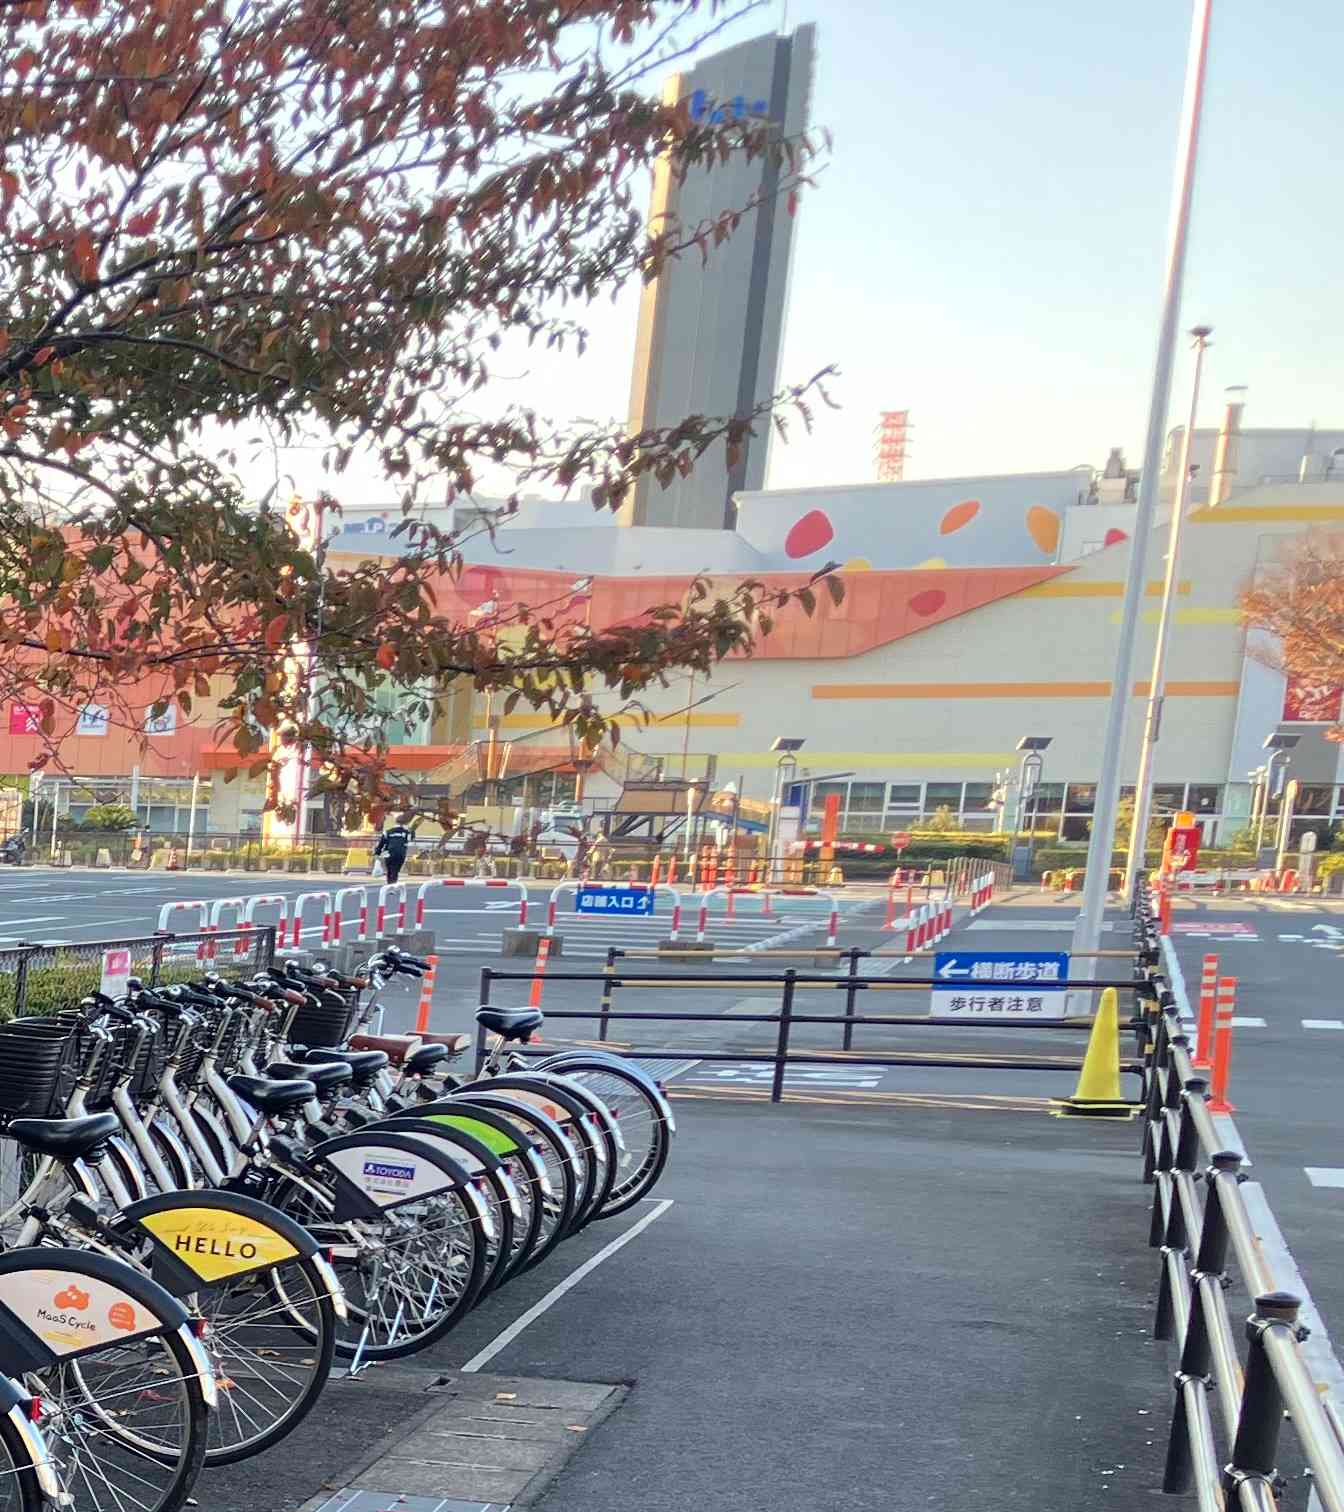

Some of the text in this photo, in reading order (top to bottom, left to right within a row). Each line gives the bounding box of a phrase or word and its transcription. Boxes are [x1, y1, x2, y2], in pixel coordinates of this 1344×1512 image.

[970, 961, 1061, 981] 横断歩道
[950, 996, 1045, 1012] 歩行者注意
[175, 1234, 257, 1260] HELLO
[37, 1309, 97, 1332] MaaS Cycle
